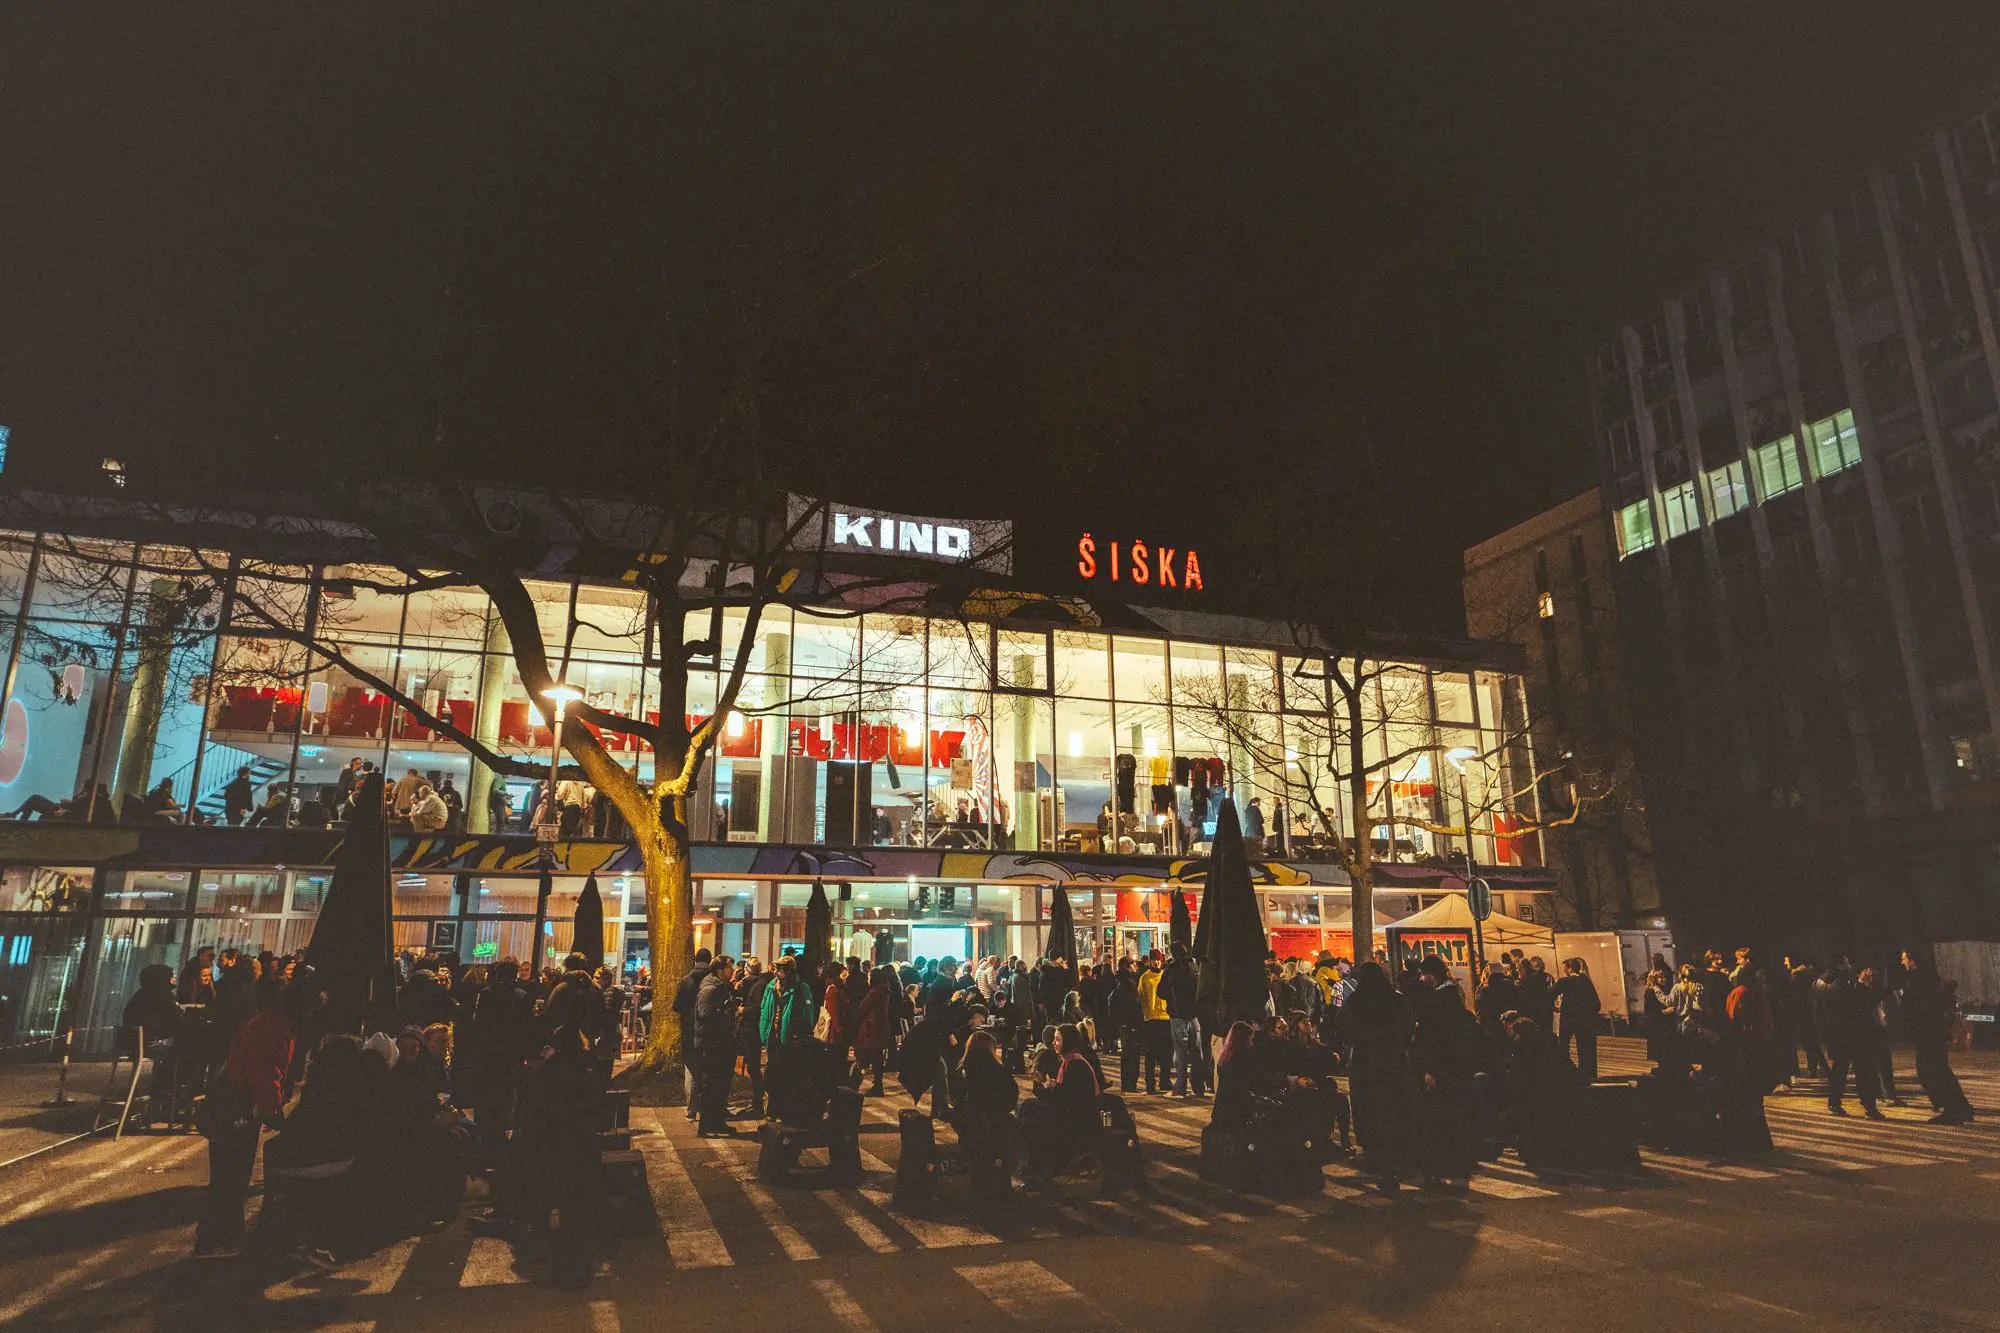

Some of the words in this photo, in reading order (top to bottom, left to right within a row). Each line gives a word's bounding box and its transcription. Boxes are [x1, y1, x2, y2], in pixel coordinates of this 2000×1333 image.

[833, 513, 971, 559] KINO
[1078, 532, 1203, 591] ŠIŠKA
[1401, 940, 1466, 962] MENT
